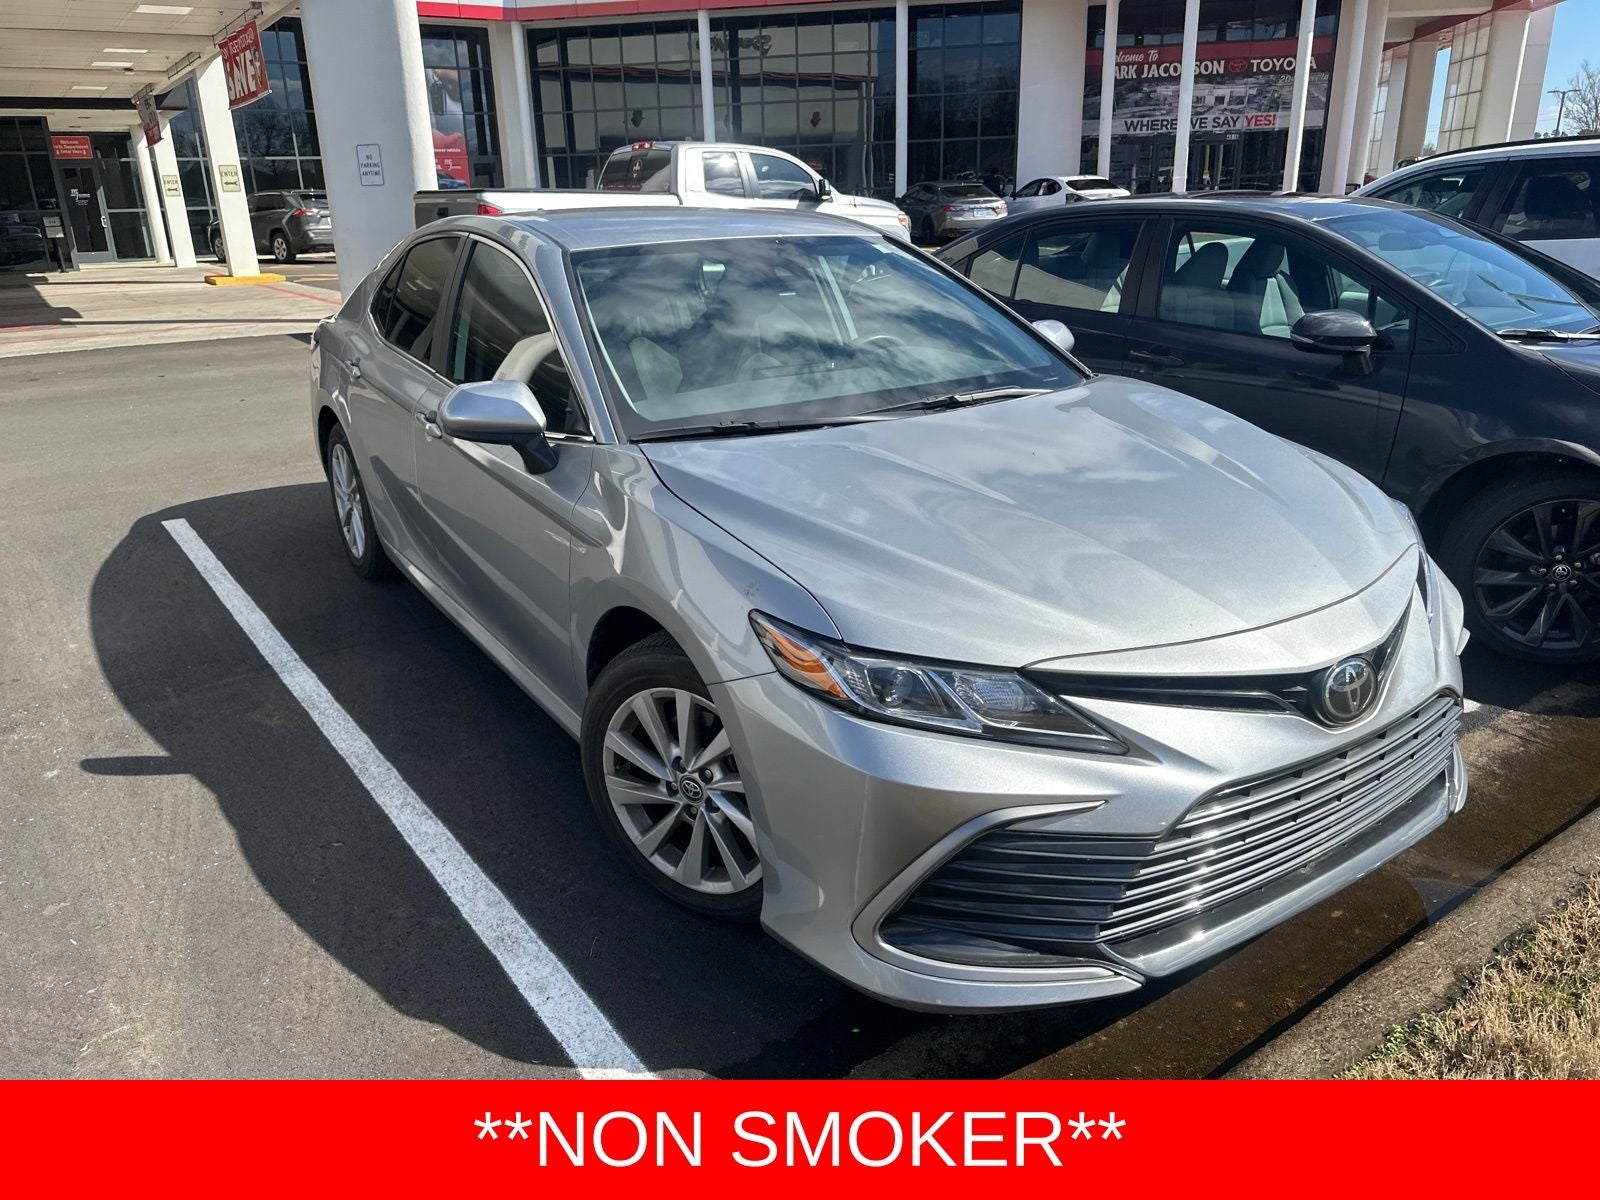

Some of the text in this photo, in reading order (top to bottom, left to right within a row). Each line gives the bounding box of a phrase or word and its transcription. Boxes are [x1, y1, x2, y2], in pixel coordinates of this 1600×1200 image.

[1114, 50, 1158, 63] elcome To
[1114, 57, 1317, 79] ARK JACOSON TOYOA
[1124, 118, 1178, 132] WHERE
[1212, 116, 1240, 129] SAY
[1246, 114, 1277, 127] YES!
